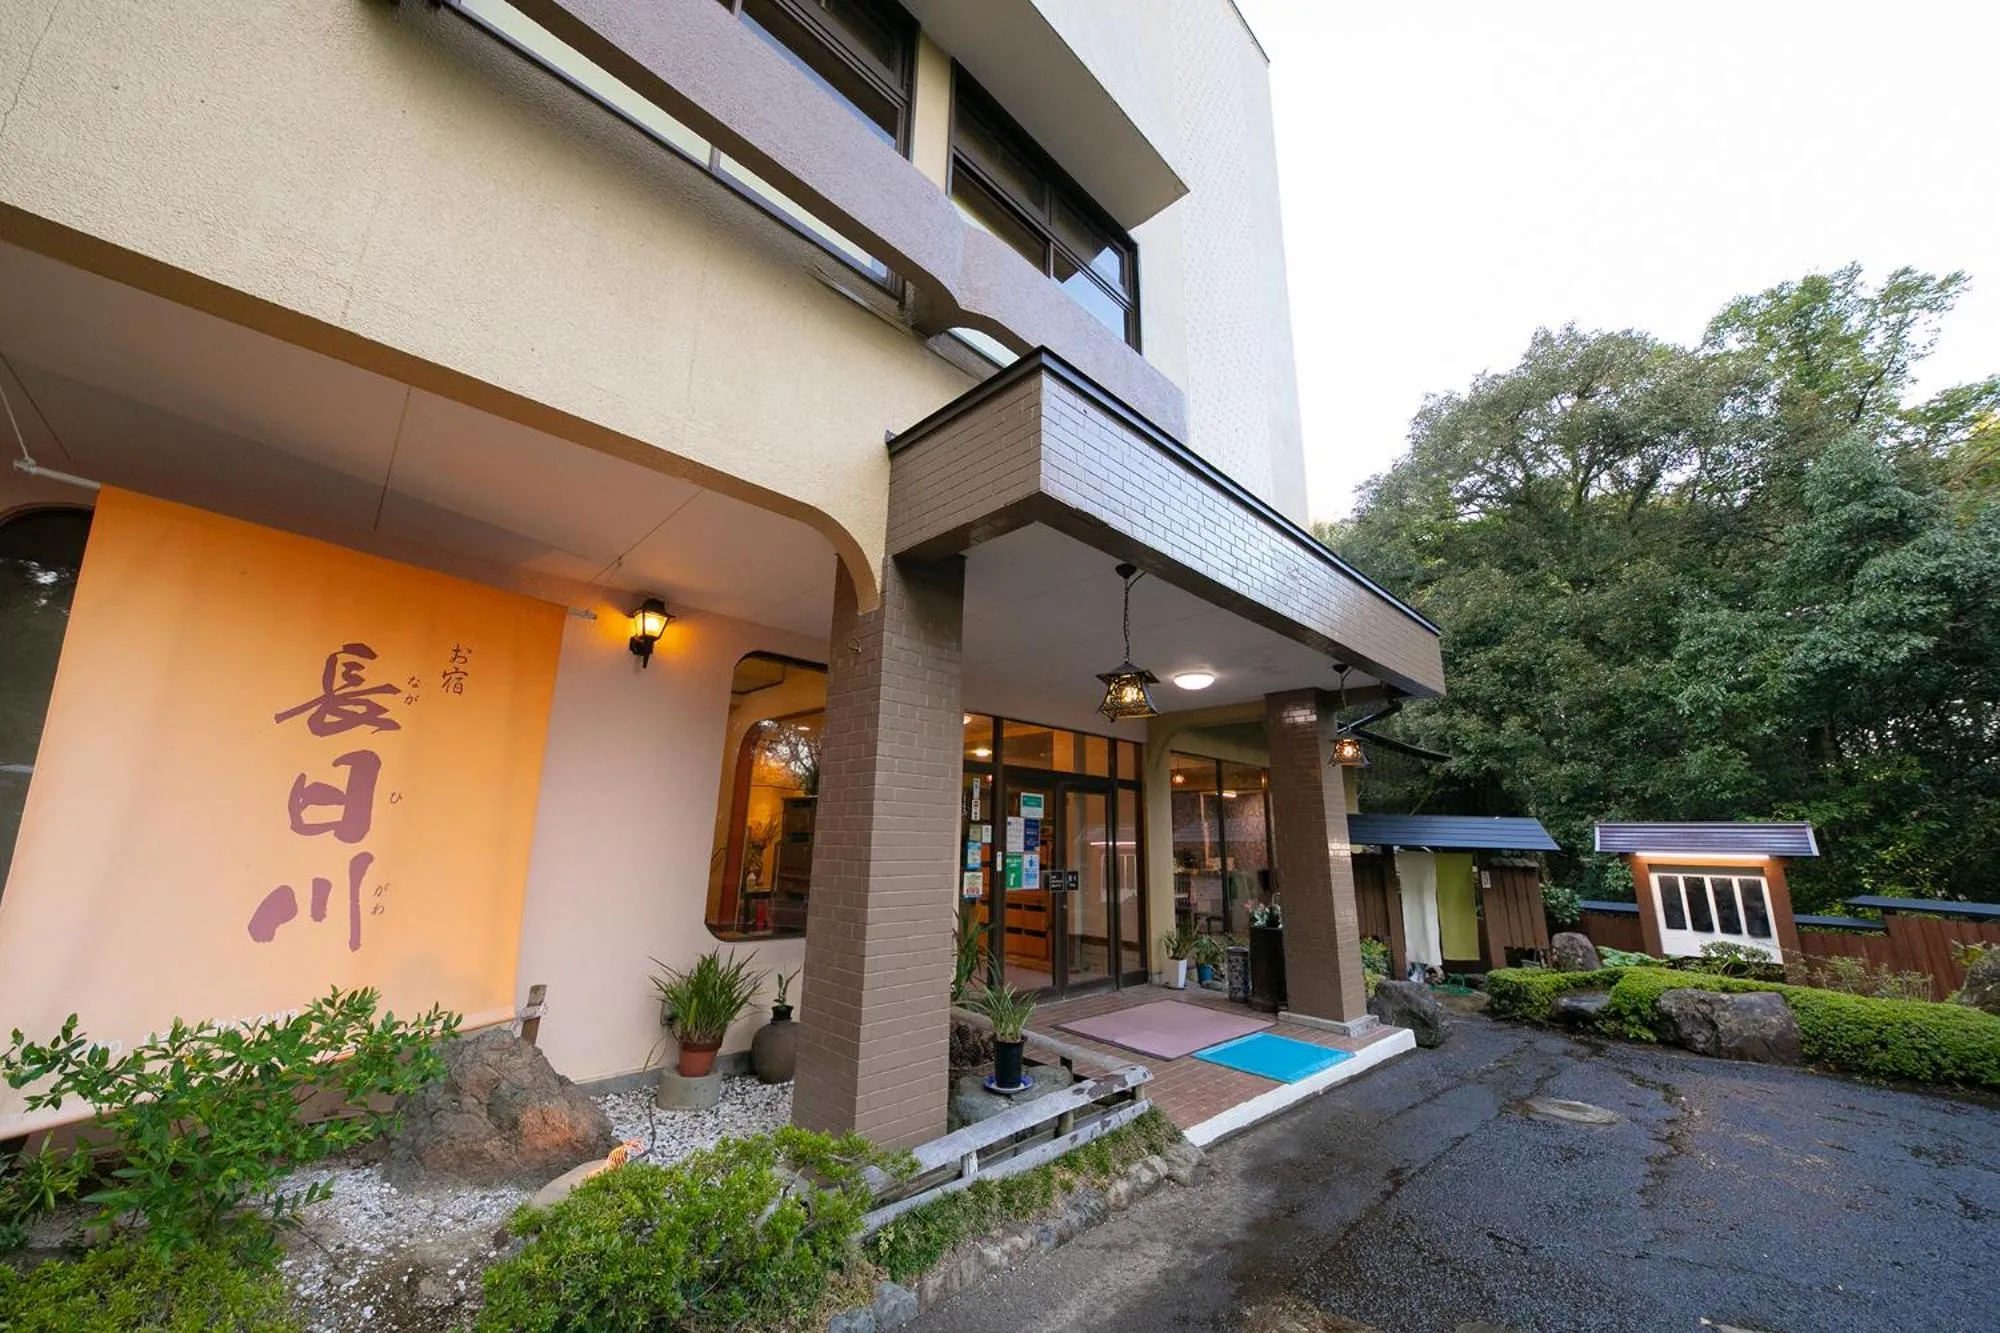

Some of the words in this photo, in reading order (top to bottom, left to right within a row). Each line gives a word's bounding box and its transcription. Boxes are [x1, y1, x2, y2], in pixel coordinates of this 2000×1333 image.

[441, 643, 472, 696] お宿
[404, 675, 421, 705] なが
[248, 643, 402, 952] 長日川
[389, 791, 403, 805] ひ
[370, 881, 390, 916] がわ
